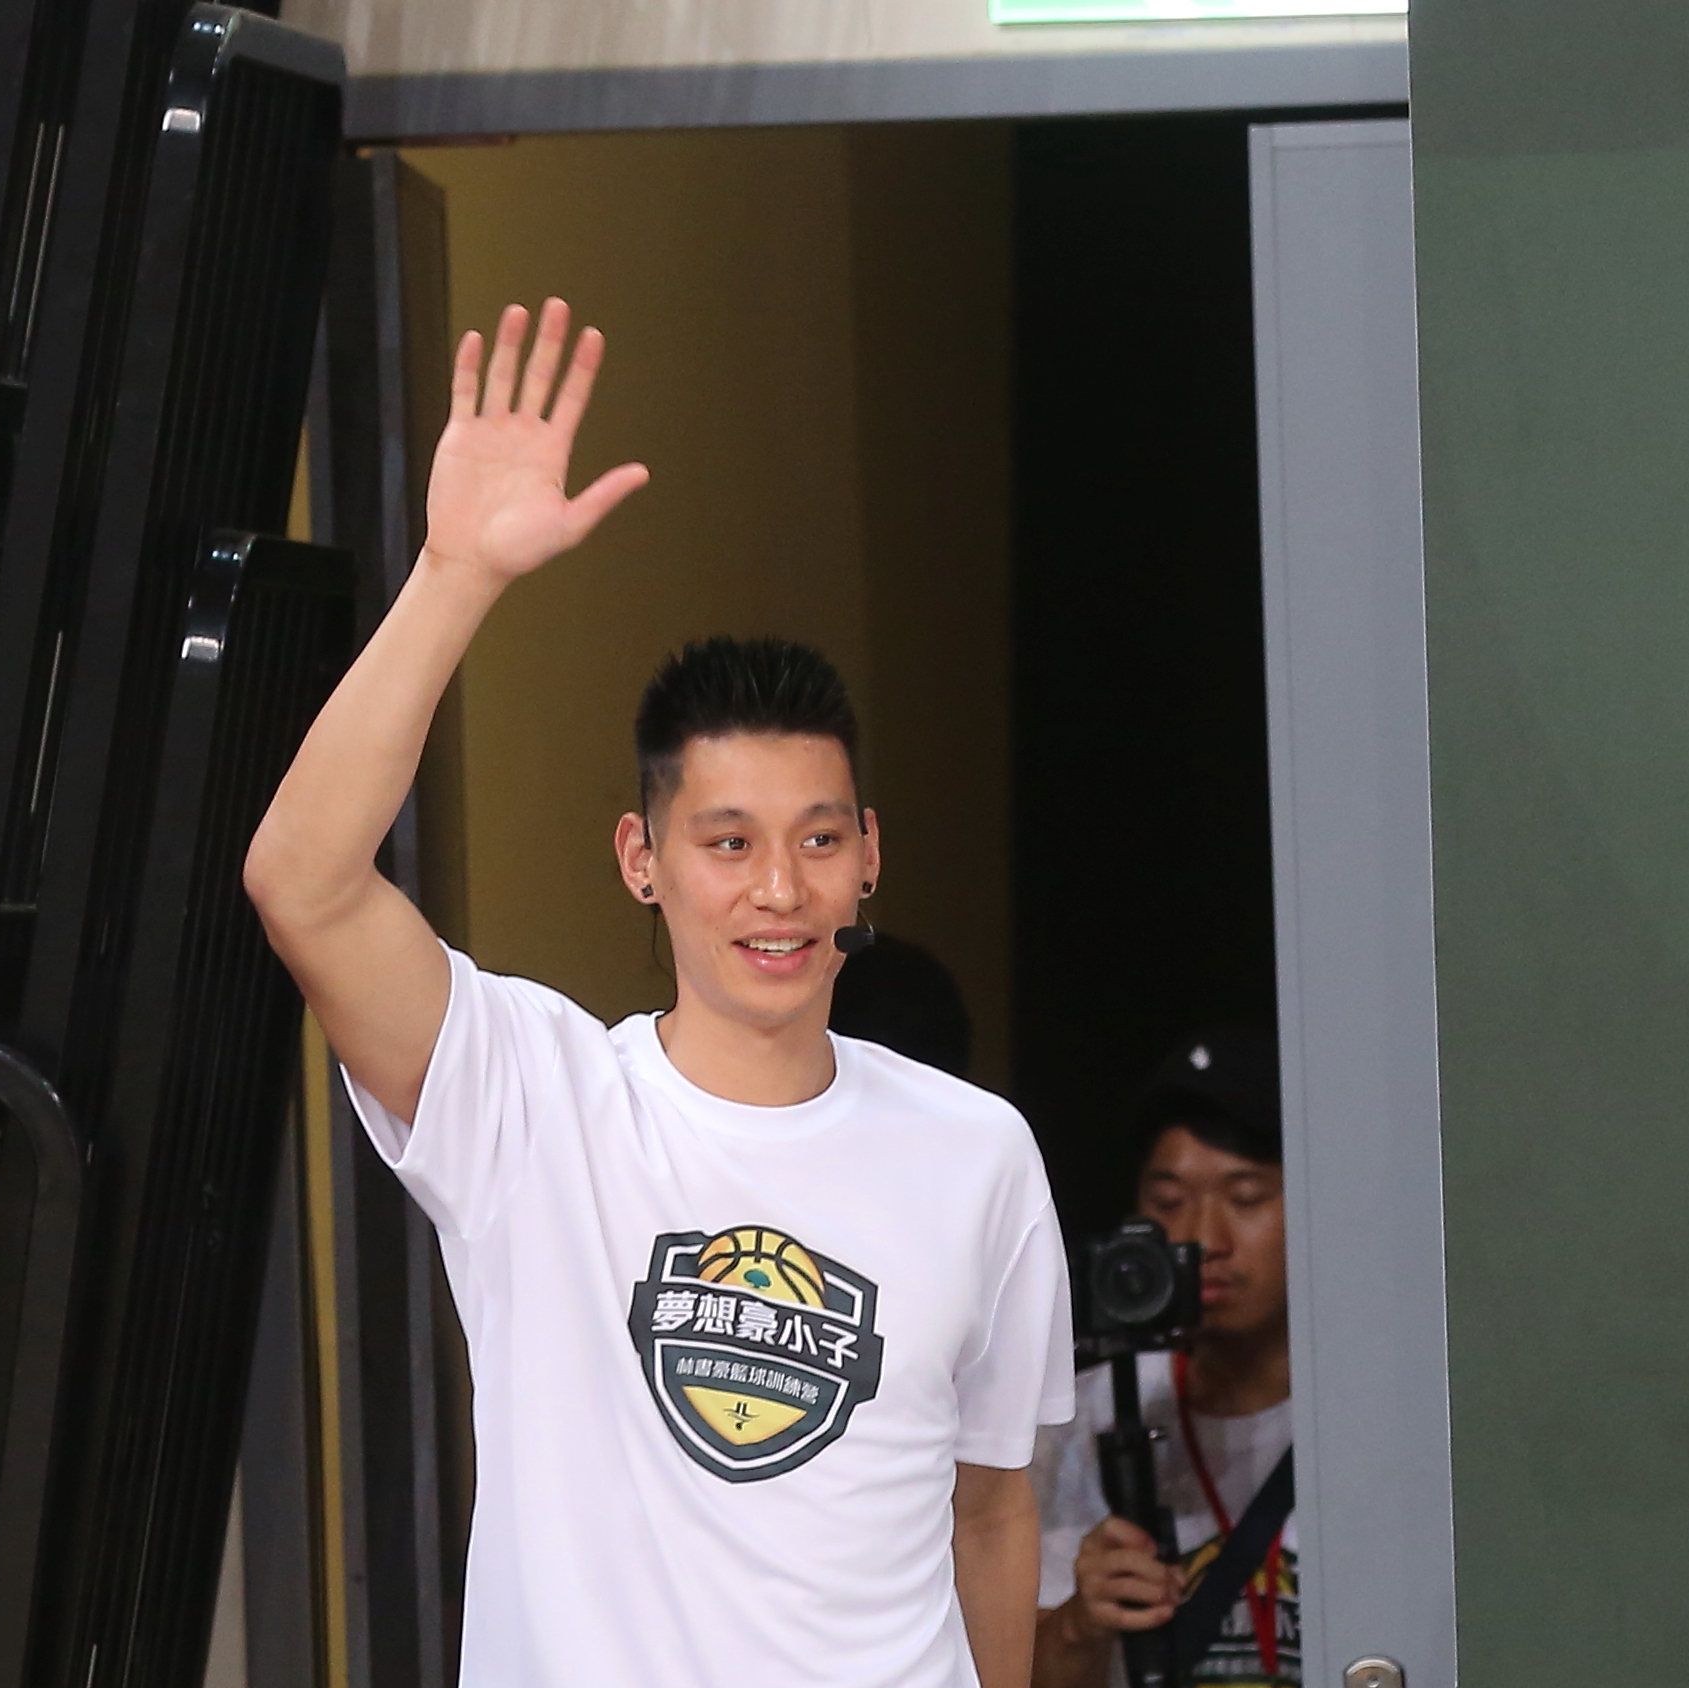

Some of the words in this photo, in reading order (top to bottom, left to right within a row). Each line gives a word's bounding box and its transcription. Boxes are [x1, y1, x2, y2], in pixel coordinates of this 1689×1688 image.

[651, 1290, 860, 1369] 夢想豪小子
